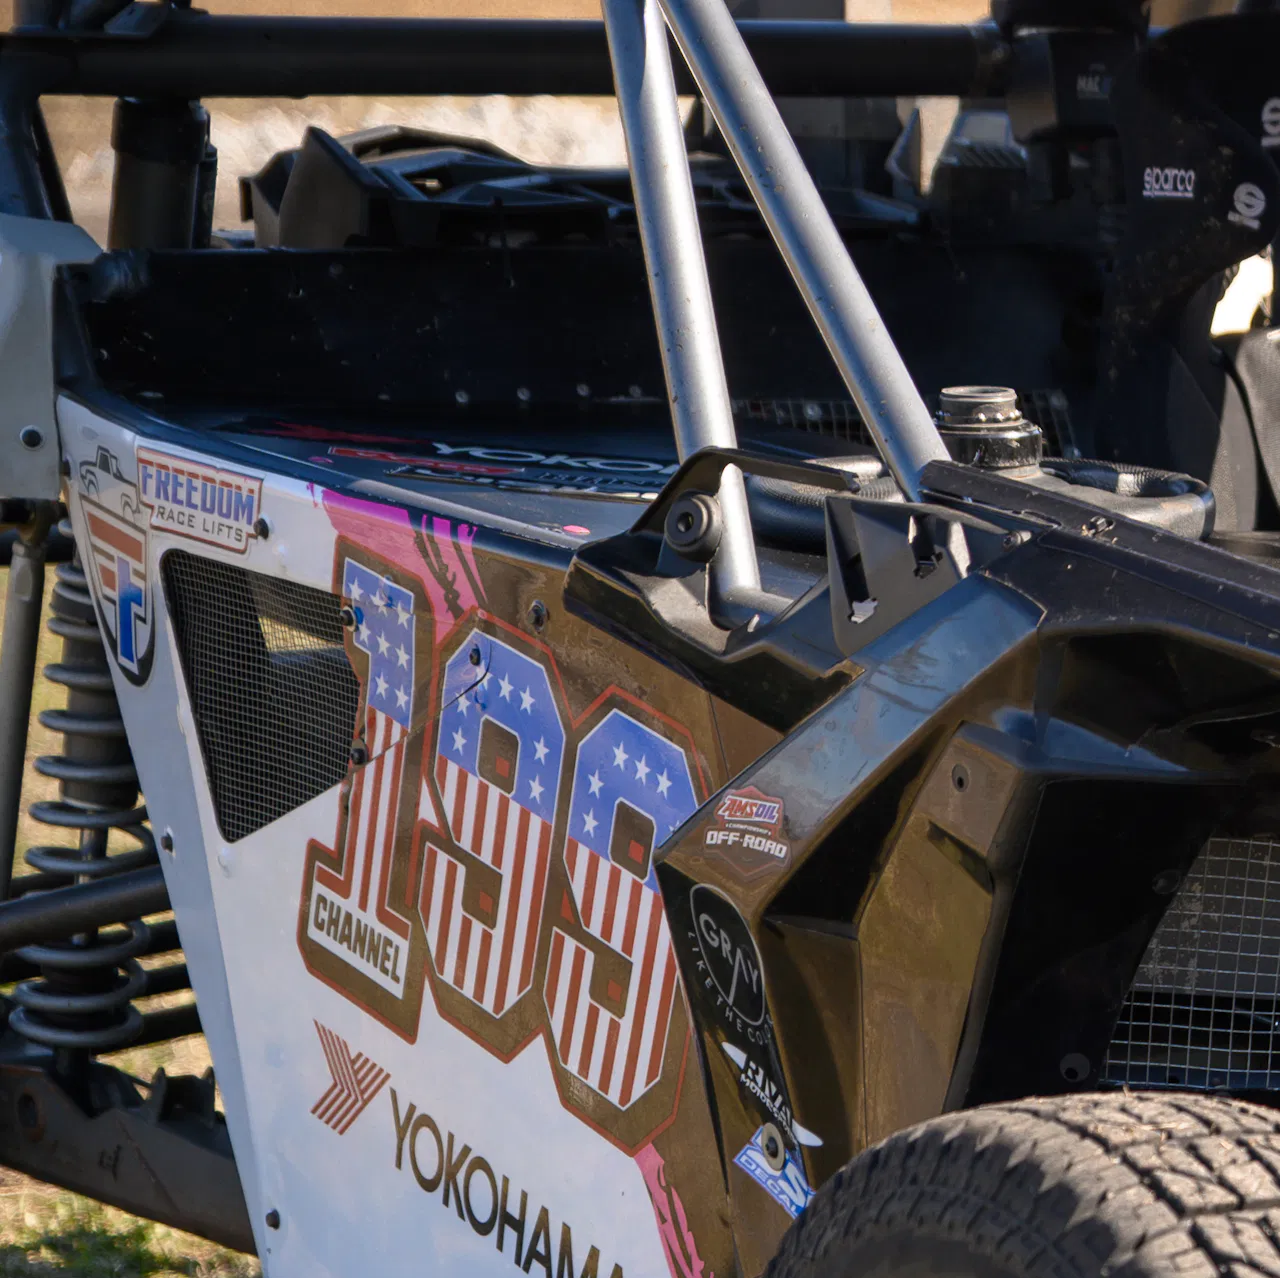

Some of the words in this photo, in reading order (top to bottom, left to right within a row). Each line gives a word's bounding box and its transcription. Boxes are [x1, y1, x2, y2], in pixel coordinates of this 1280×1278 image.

[1143, 167, 1195, 198] sparco
[431, 442, 680, 475] YOKO
[137, 457, 255, 527] FREEDOM
[156, 505, 197, 530] RACE
[202, 517, 243, 543] LIFTS
[719, 796, 779, 822] AMSOIL
[312, 893, 401, 985] CHANNEL
[699, 913, 760, 1006] GRAY
[716, 993, 745, 1033] THE
